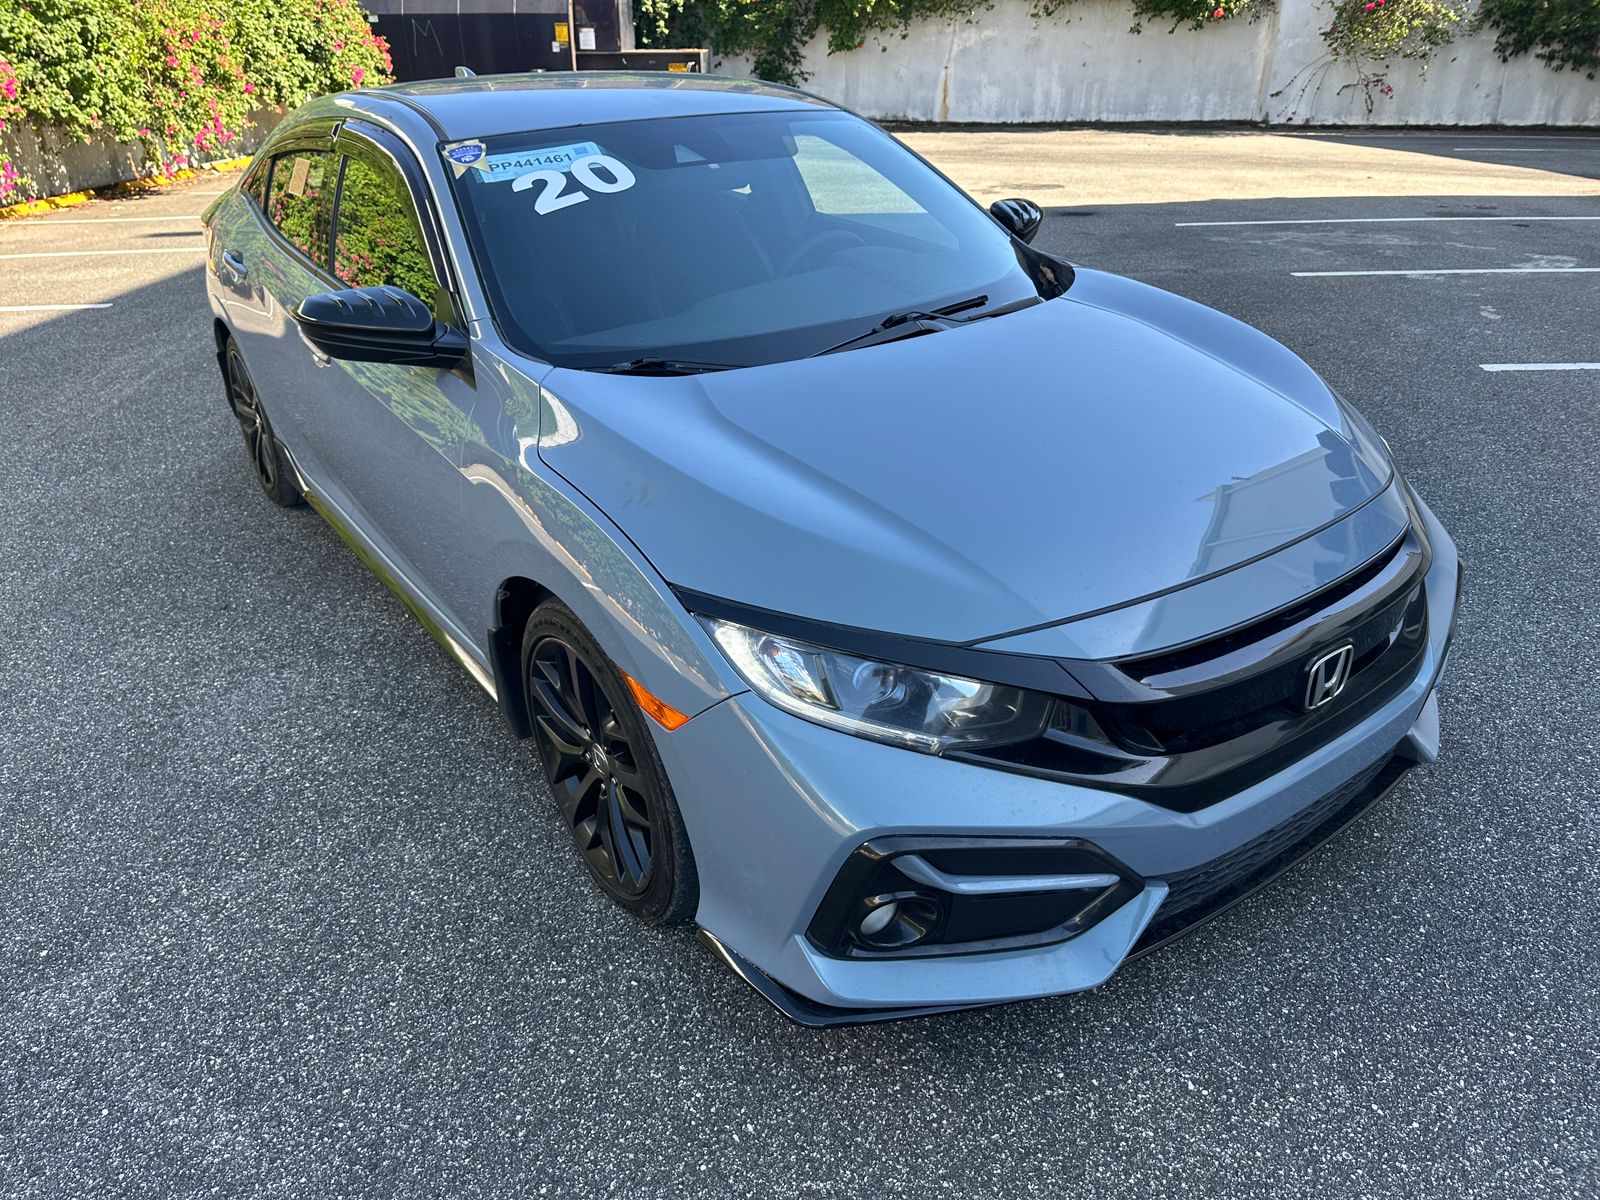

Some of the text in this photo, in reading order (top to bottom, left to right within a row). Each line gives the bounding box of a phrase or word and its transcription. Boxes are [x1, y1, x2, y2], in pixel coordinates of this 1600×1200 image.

[411, 18, 443, 56] M
[489, 153, 573, 172] PP441461
[512, 154, 636, 215] 20
